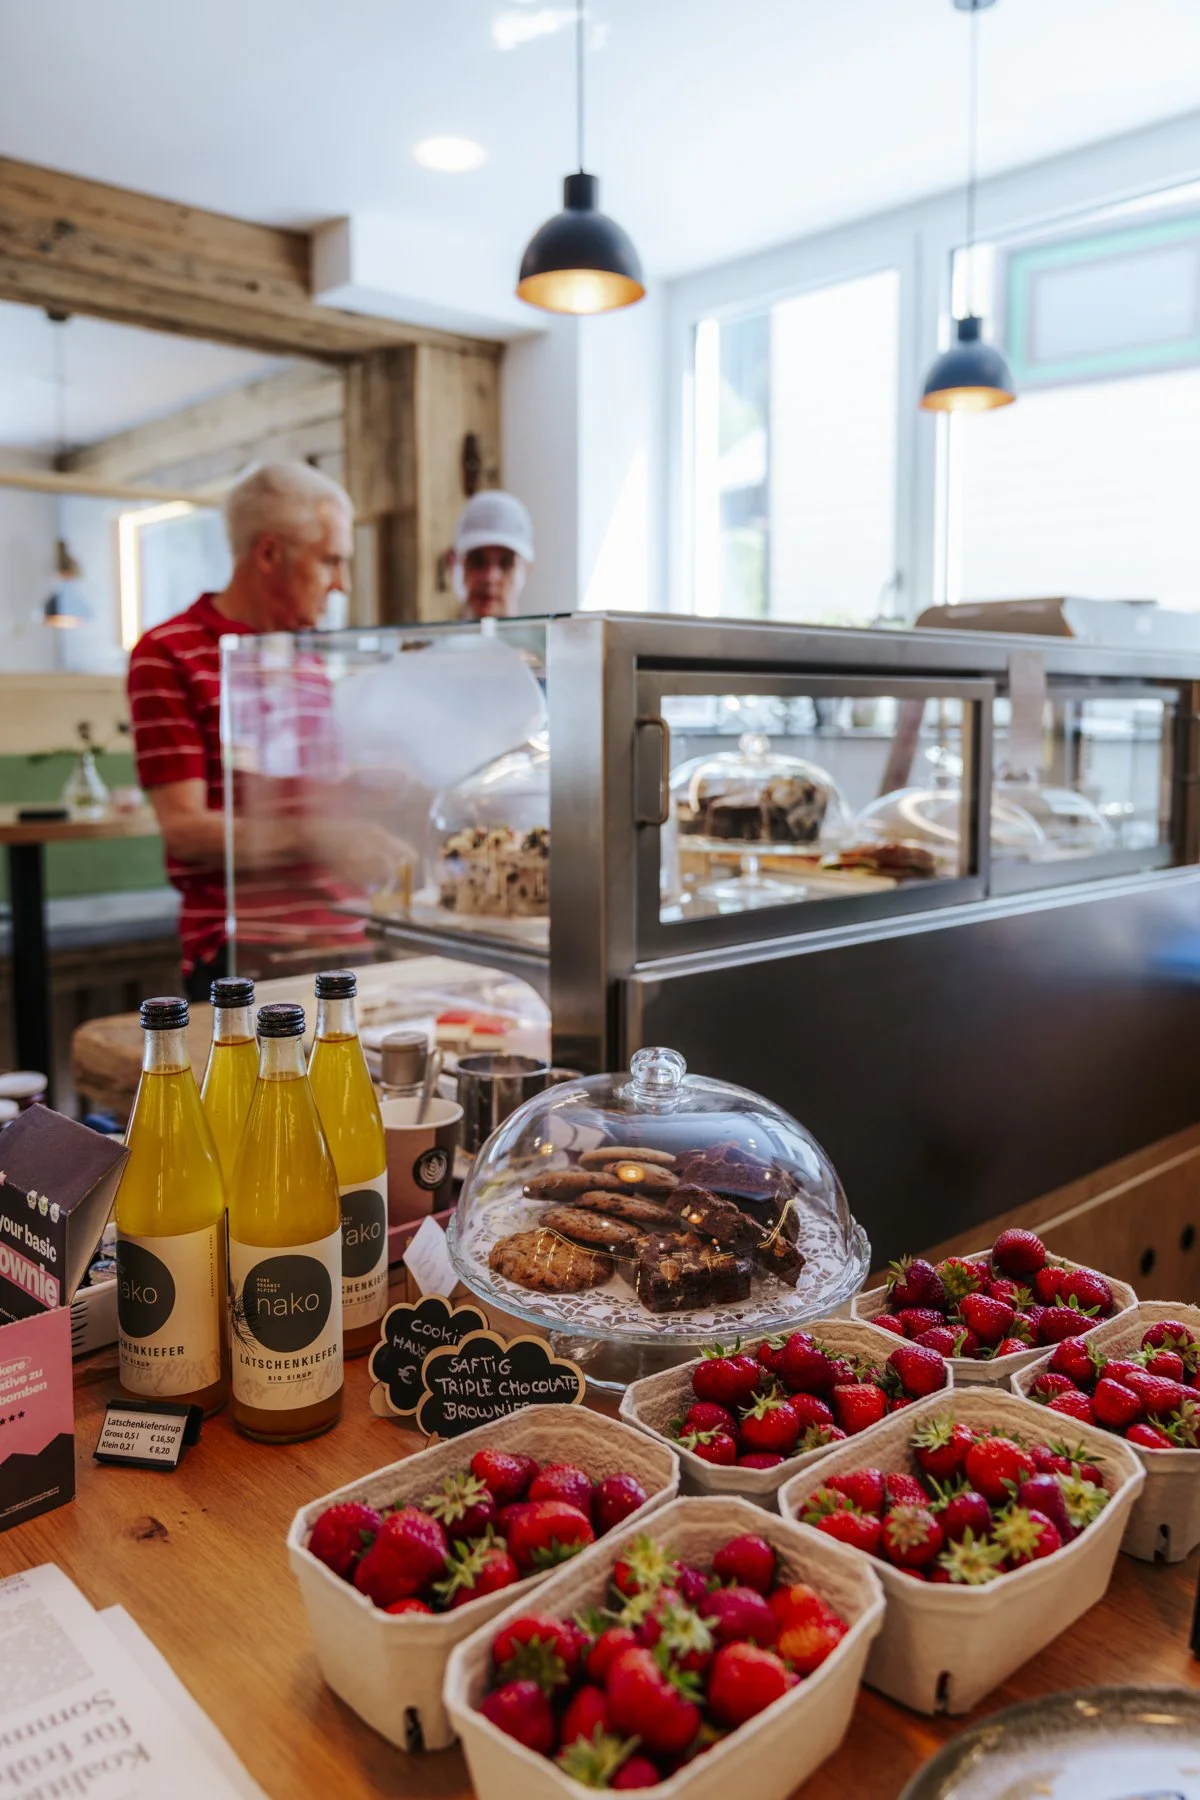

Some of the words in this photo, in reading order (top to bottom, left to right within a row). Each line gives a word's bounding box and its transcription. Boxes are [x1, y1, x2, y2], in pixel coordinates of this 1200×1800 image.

[25, 1223, 57, 1263] basic
[257, 1293, 320, 1316] nako
[240, 1344, 337, 1370] LATSCHENKIEFER
[29, 1368, 43, 1381] zu
[287, 1371, 312, 1381] SIRUP
[397, 1365, 417, 1385] €
[107, 1418, 181, 1434] Latschenkiefersirup
[104, 1429, 123, 1438] Gross
[124, 1431, 135, 1440] 0,5
[156, 1435, 176, 1444] 16,50
[101, 1441, 119, 1449] Klein
[119, 1443, 131, 1451] 0,2
[154, 1446, 171, 1455] 8,20
